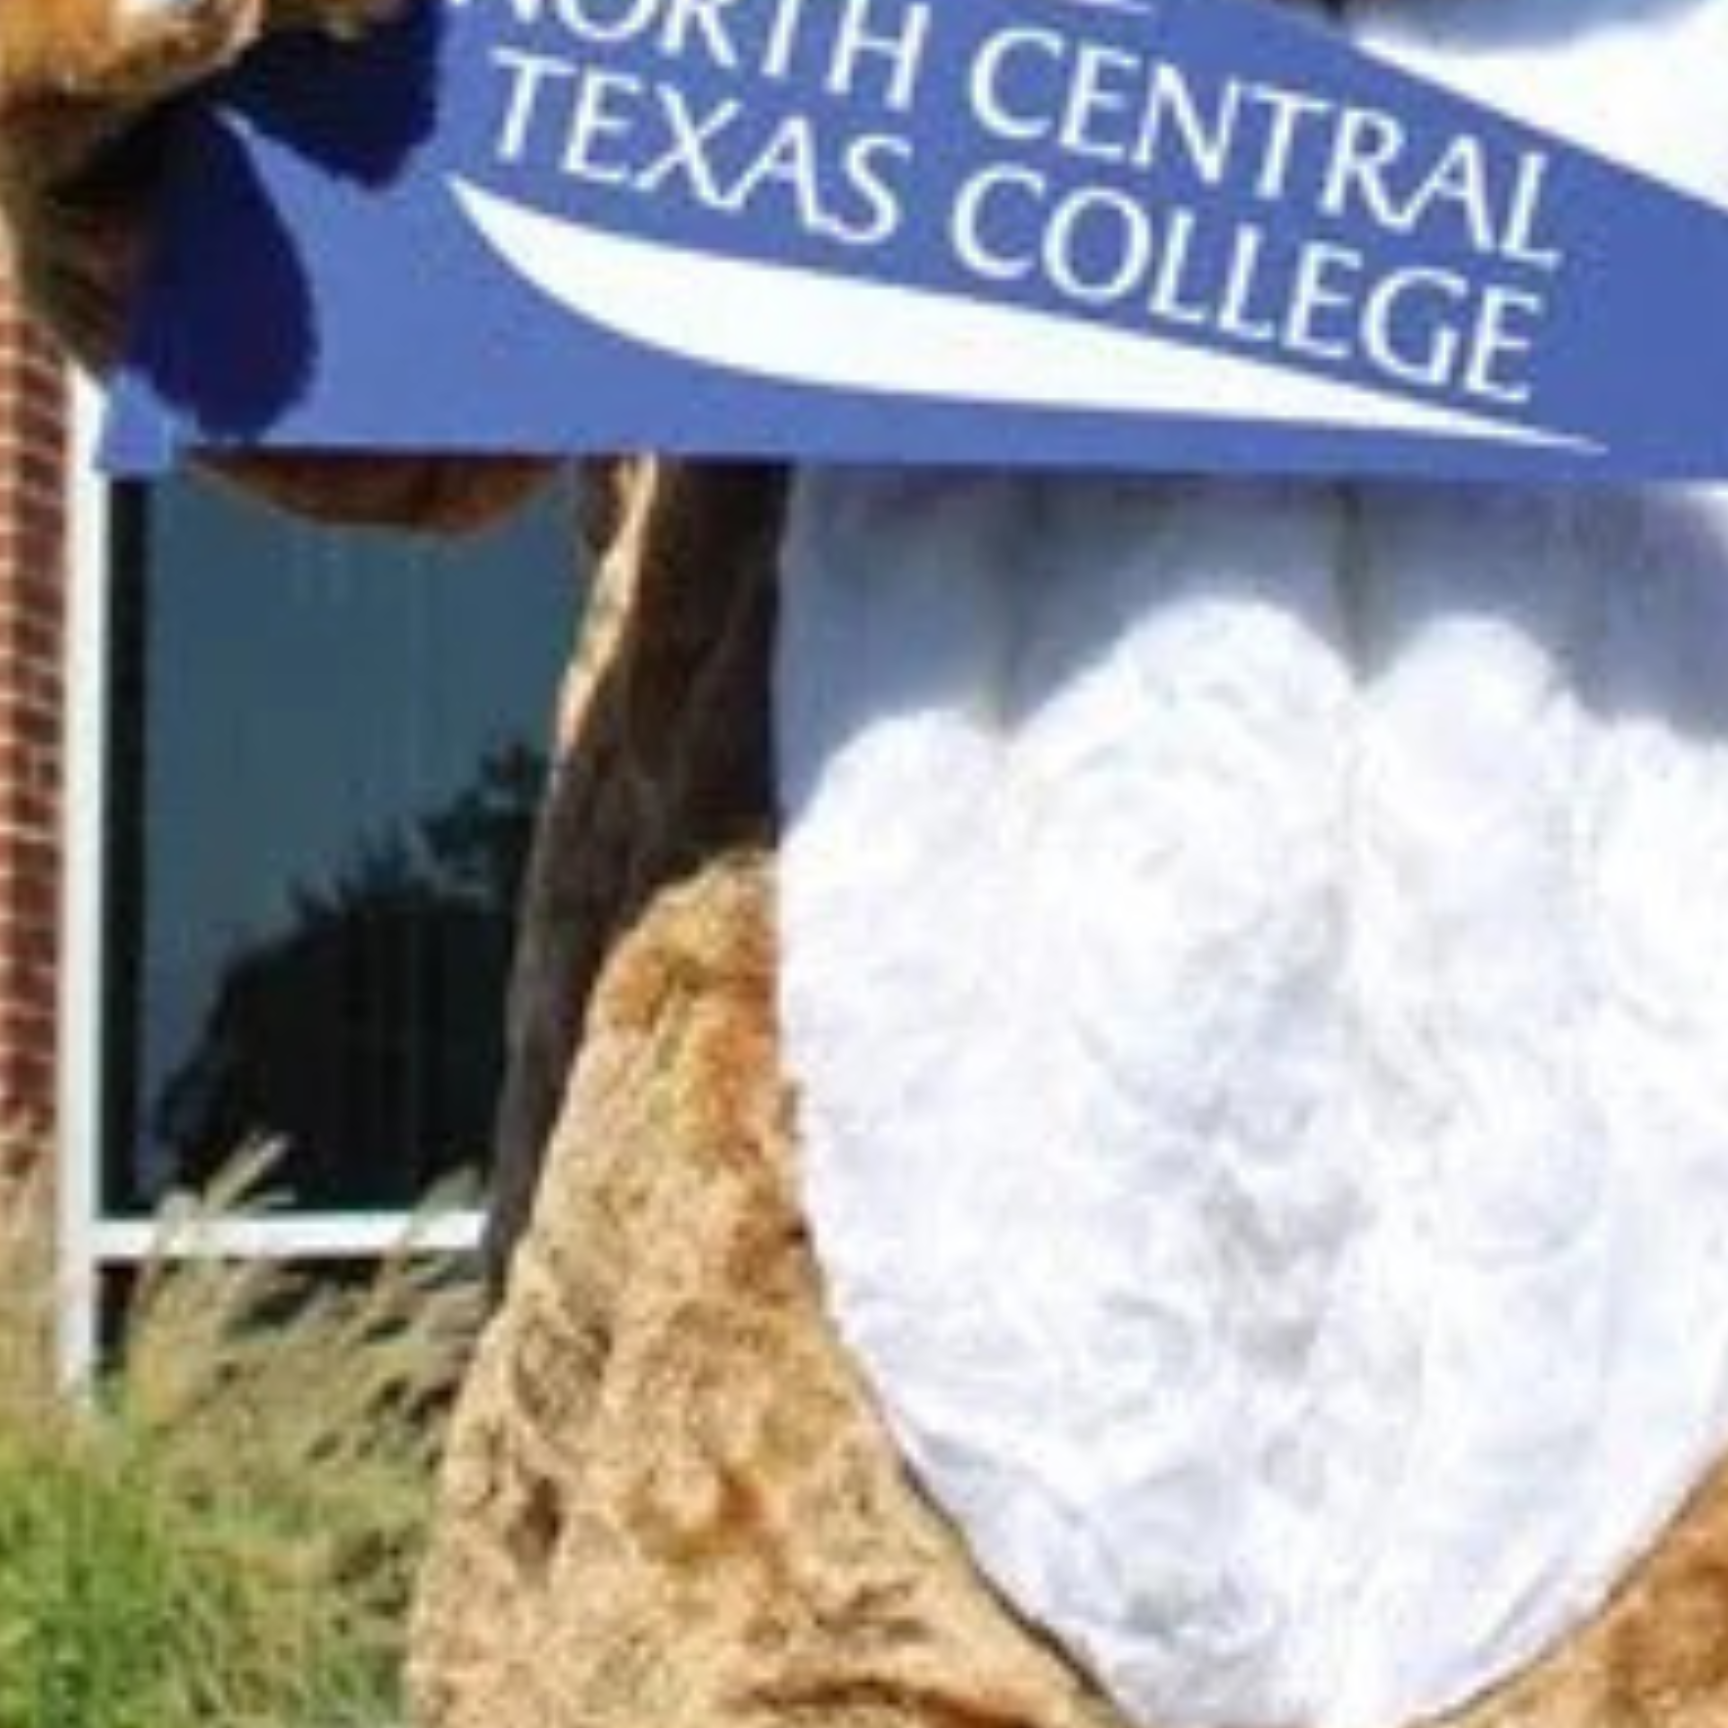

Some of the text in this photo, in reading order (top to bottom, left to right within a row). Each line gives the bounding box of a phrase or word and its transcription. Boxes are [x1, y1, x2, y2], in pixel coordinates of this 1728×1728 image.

[490, 44, 1541, 404] TEXAS COLLEGE
[968, 27, 1561, 269] CENTRAL
